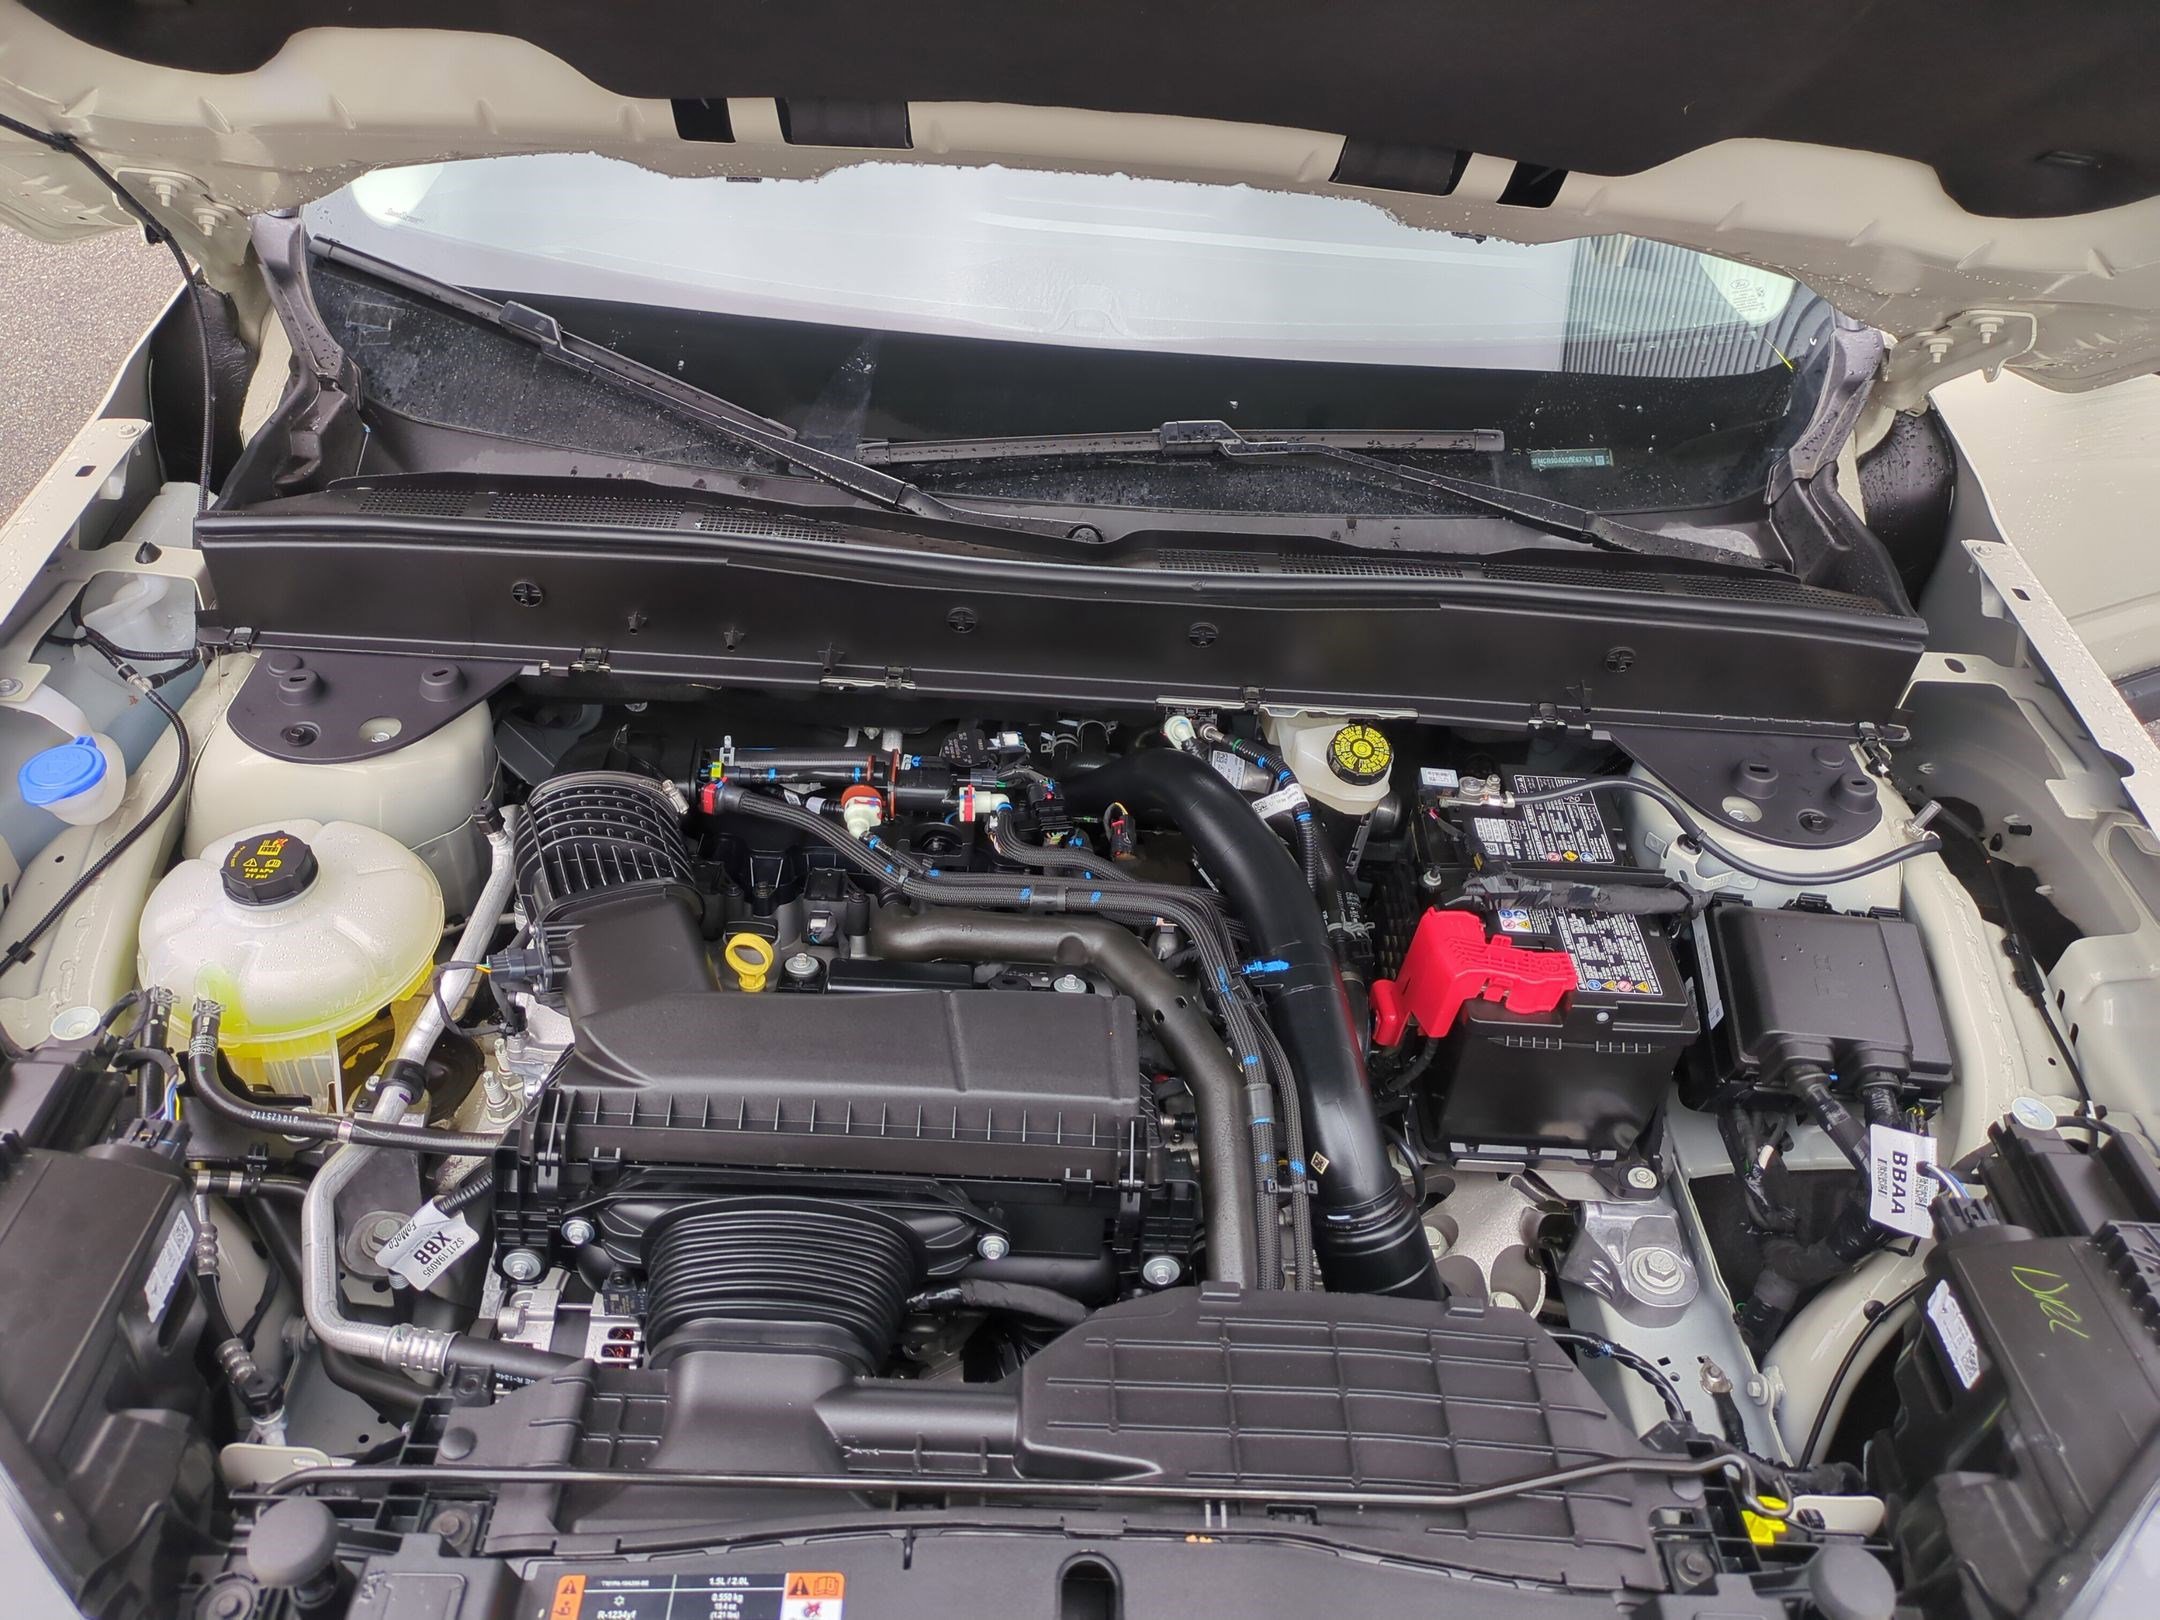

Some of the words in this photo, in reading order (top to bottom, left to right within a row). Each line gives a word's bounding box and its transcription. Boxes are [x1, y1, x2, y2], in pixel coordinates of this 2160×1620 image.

[250, 1110, 299, 1123] 010425112
[1891, 1150, 1909, 1214] BBAA
[388, 1219, 417, 1250] FoMoCo
[413, 1231, 452, 1265] XBB
[423, 1252, 449, 1278] 19A095
[708, 1577, 726, 1586] 1.5L
[732, 1577, 749, 1585] 2.0L
[711, 1593, 732, 1602] 0.550
[733, 1593, 744, 1603] kg
[597, 1610, 637, 1620] R-1234yf
